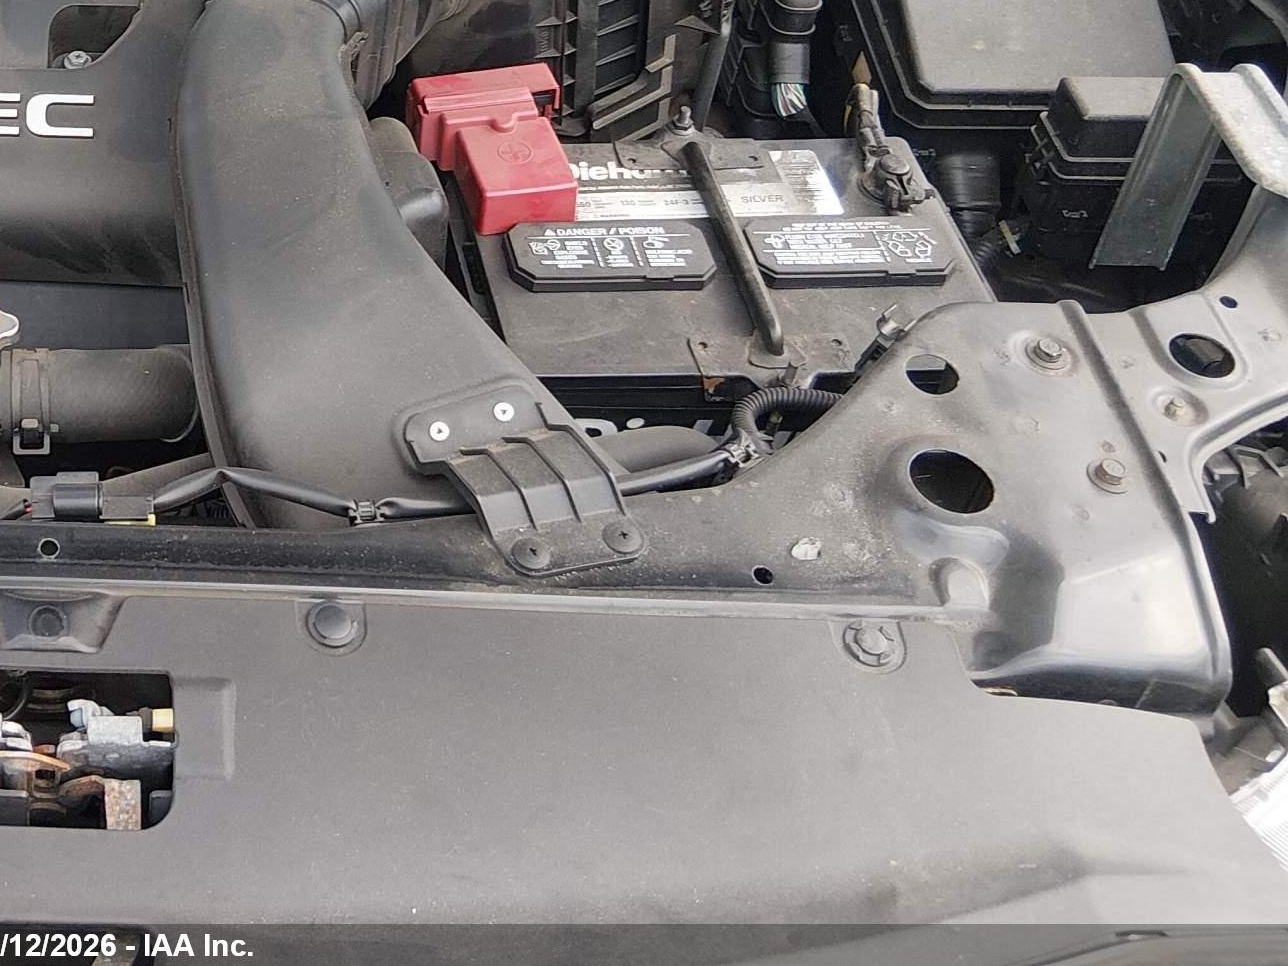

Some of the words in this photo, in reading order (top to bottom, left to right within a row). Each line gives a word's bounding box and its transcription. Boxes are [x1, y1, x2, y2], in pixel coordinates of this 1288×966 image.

[740, 193, 785, 204] SILVER
[557, 227, 608, 236] DANGER
[618, 226, 665, 235] POISON
